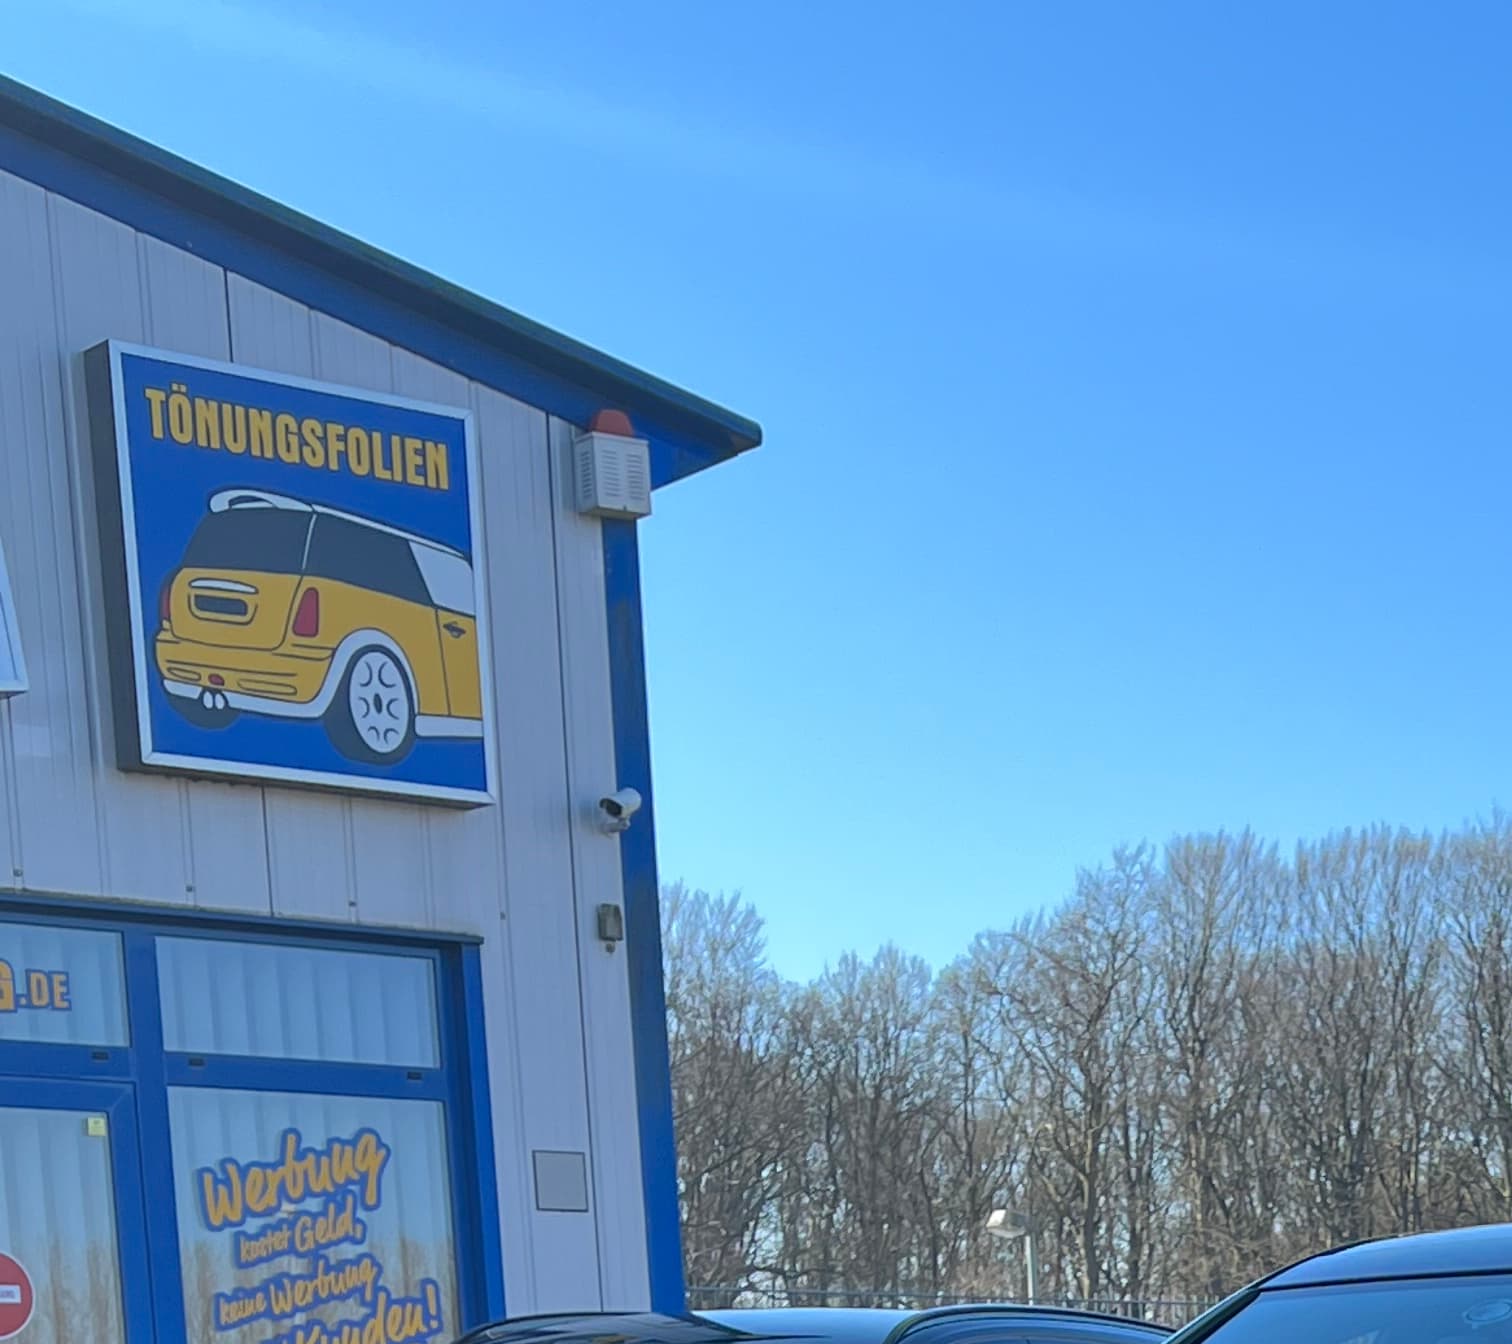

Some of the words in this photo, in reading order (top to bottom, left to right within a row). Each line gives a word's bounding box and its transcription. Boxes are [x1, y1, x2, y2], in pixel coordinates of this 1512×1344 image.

[144, 383, 450, 490] TÖNUNGSFOLIEN
[203, 1130, 386, 1227] Werbung
[239, 1223, 291, 1263] kostet
[293, 1193, 362, 1252] Geld,
[218, 1292, 265, 1325] keine
[268, 1257, 378, 1315] Werbung
